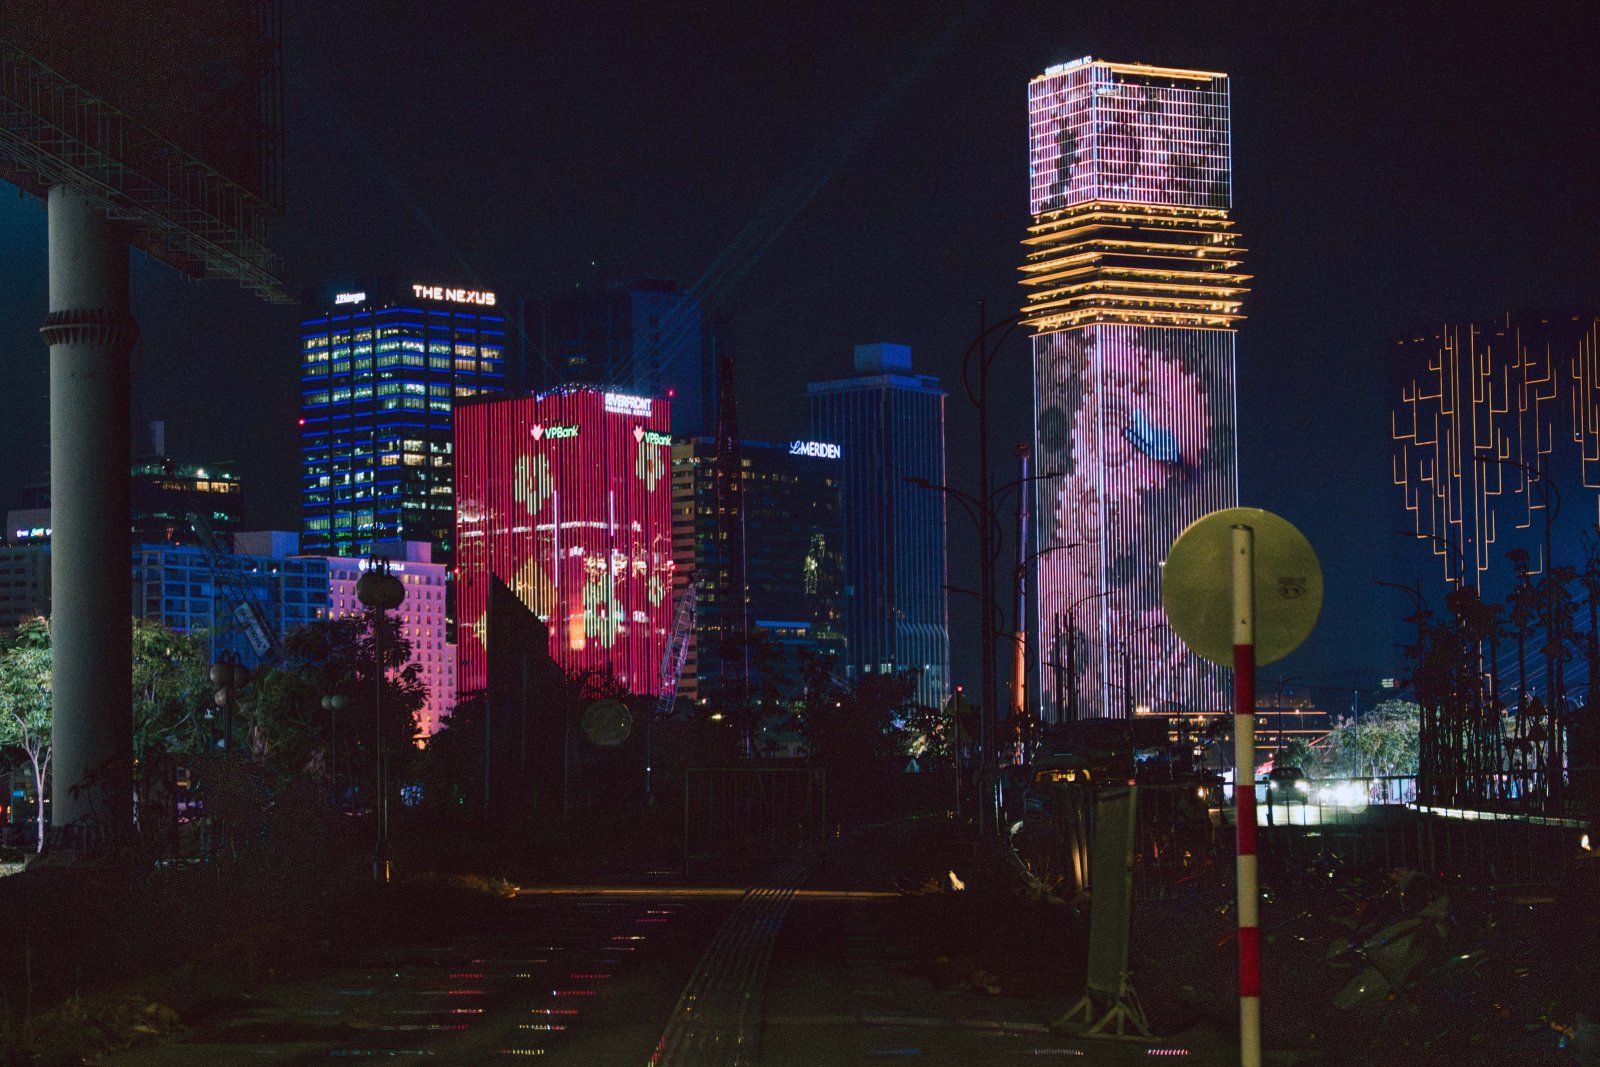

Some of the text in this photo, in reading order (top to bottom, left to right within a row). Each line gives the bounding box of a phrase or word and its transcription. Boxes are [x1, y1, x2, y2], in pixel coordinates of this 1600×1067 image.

[412, 284, 496, 305] THE NEXUS
[605, 392, 652, 410] RIVERFRONT
[545, 424, 579, 440] VPBank
[645, 431, 673, 446] VPBank
[800, 441, 841, 459] MERIDIEN
